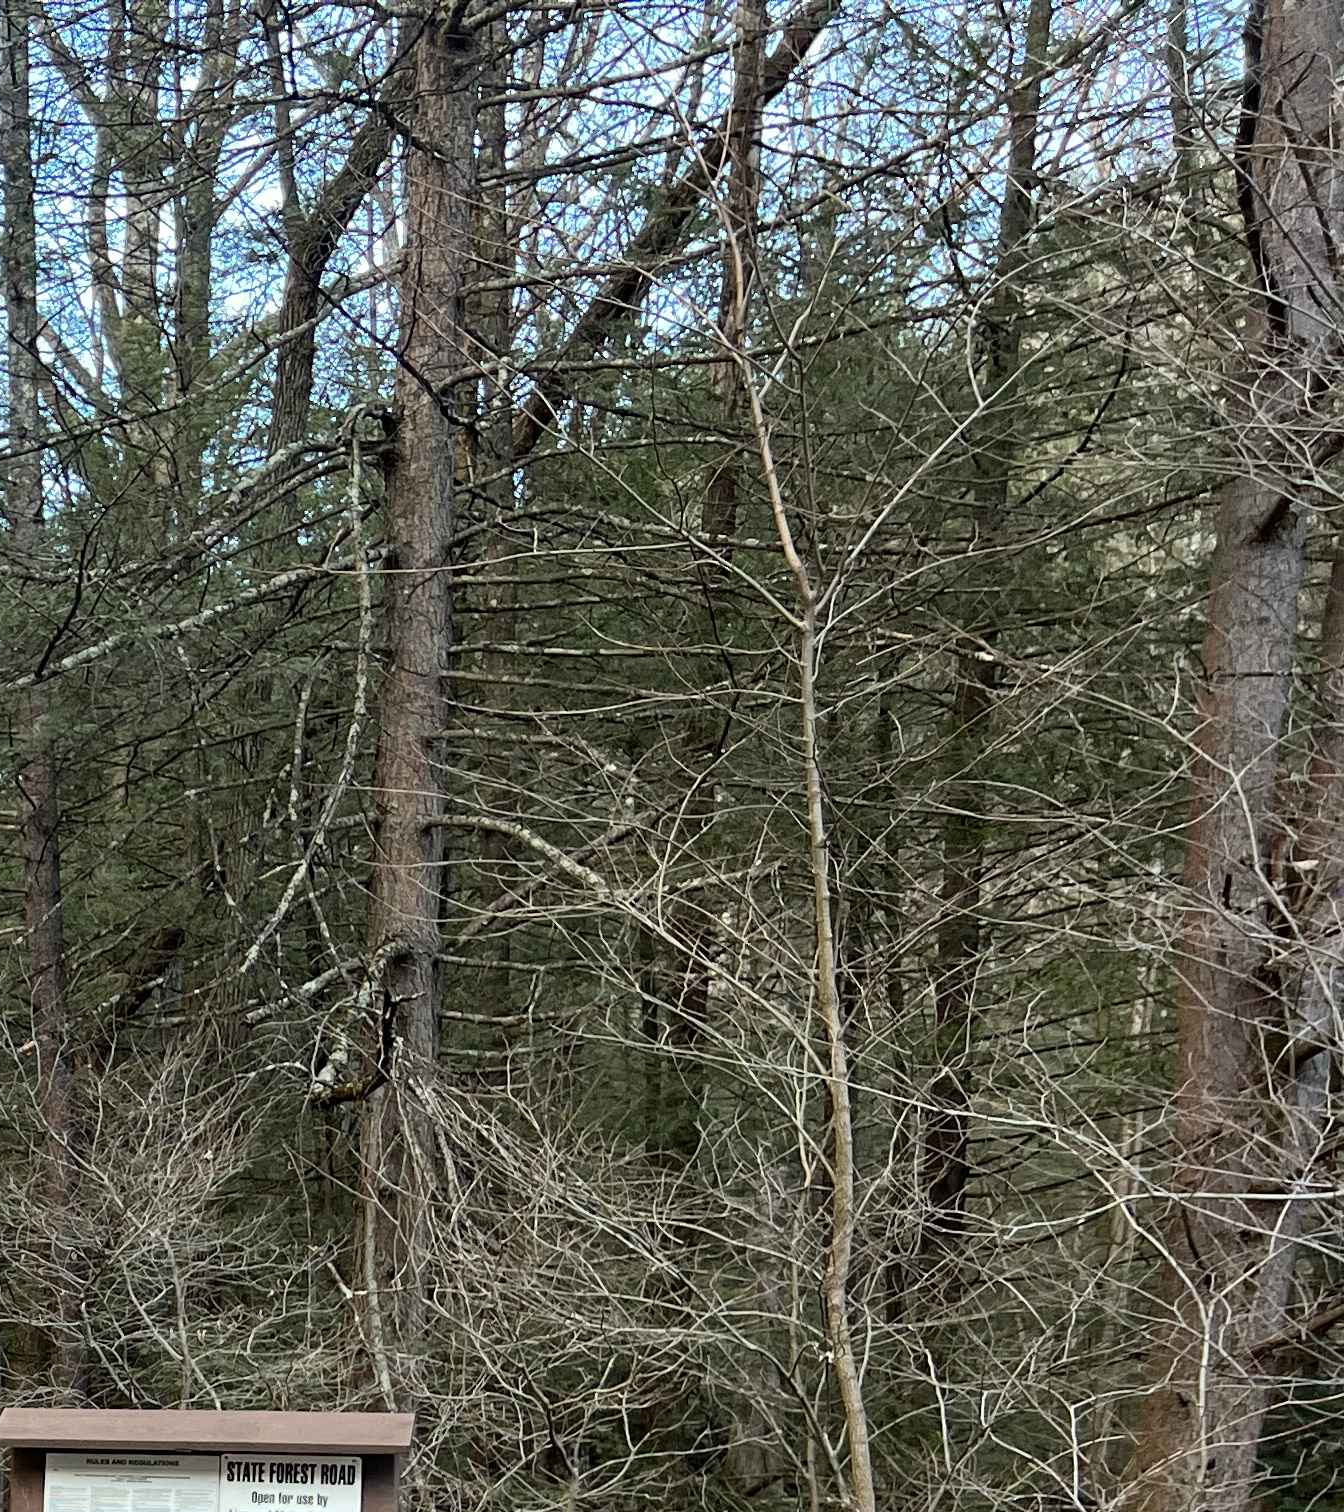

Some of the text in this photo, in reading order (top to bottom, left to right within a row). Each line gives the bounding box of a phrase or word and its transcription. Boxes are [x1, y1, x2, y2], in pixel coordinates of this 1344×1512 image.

[226, 1461, 356, 1485] STATE FOREST ROAD
[251, 1491, 328, 1507] Open for use by
